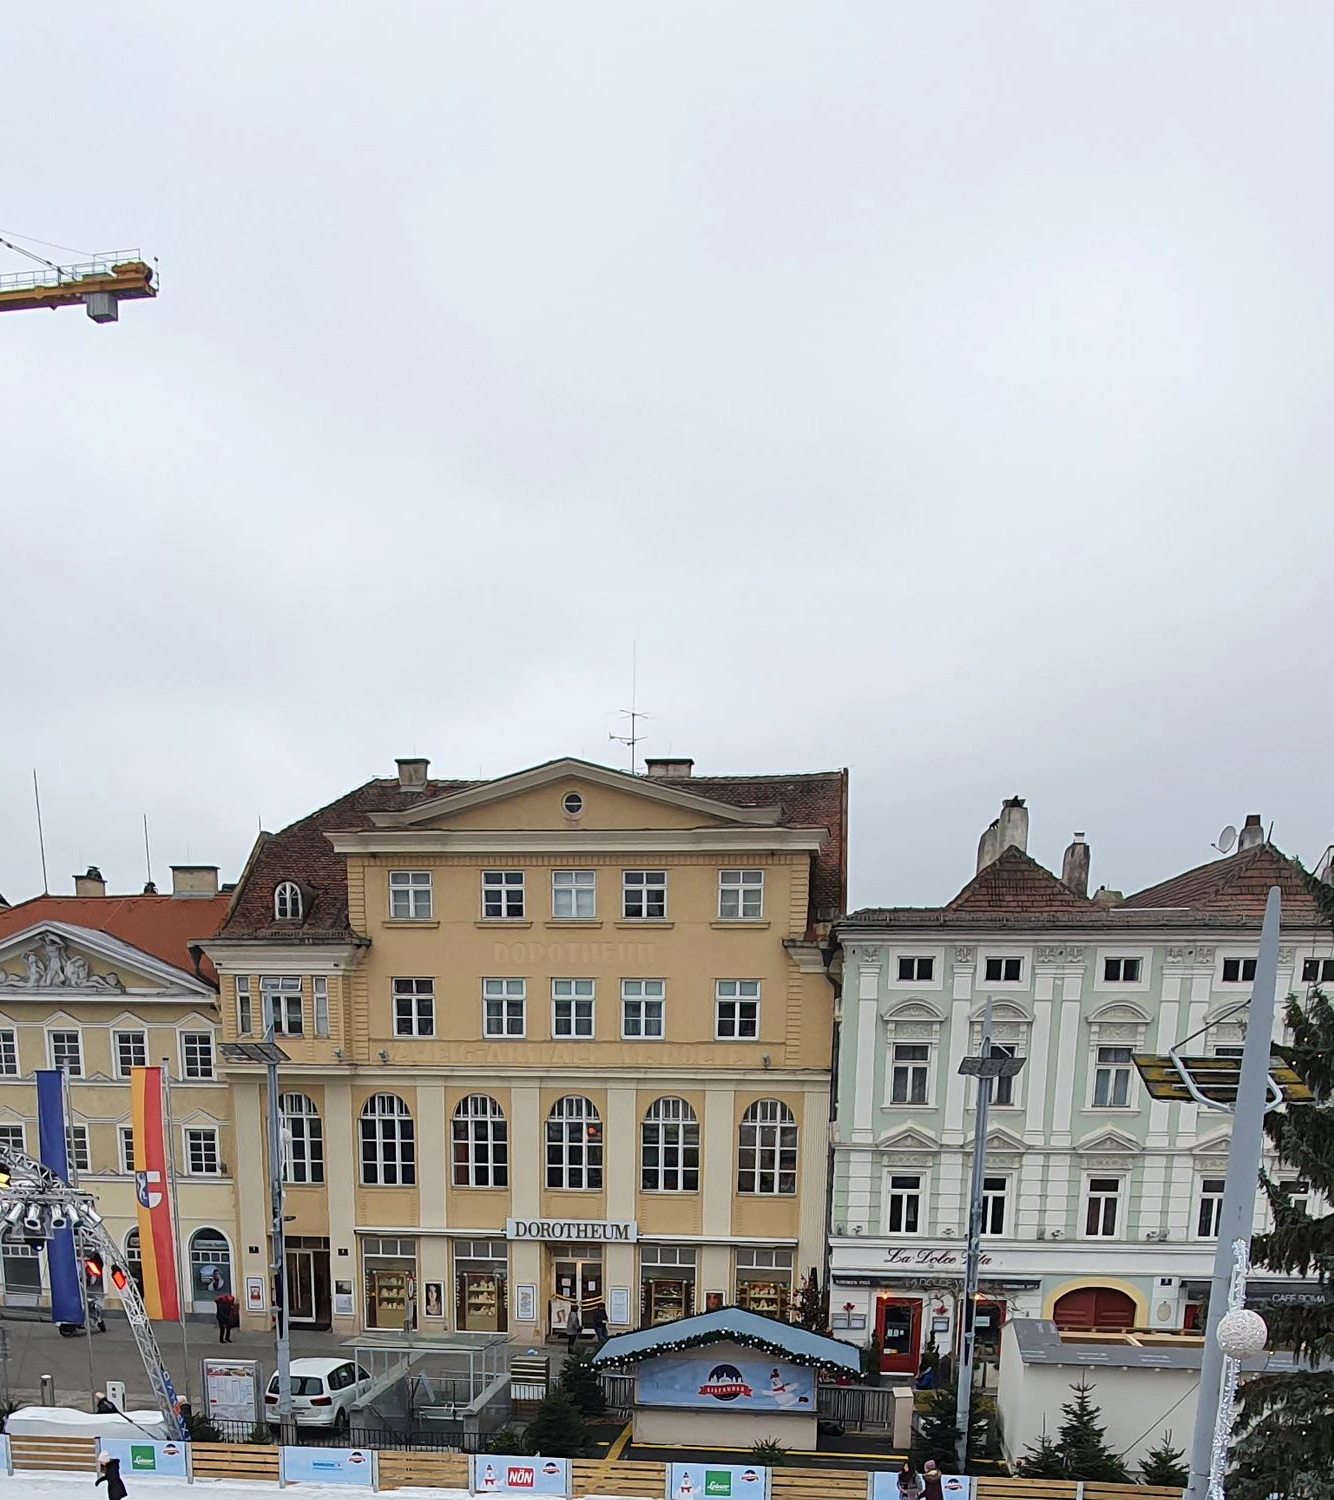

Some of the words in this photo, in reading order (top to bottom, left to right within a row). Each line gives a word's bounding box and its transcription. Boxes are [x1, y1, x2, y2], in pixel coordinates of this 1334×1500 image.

[514, 1221, 631, 1240] DOROTHEUM
[883, 1247, 911, 1264] La
[915, 1248, 957, 1265] Dolce
[508, 1469, 533, 1484] NÖN
